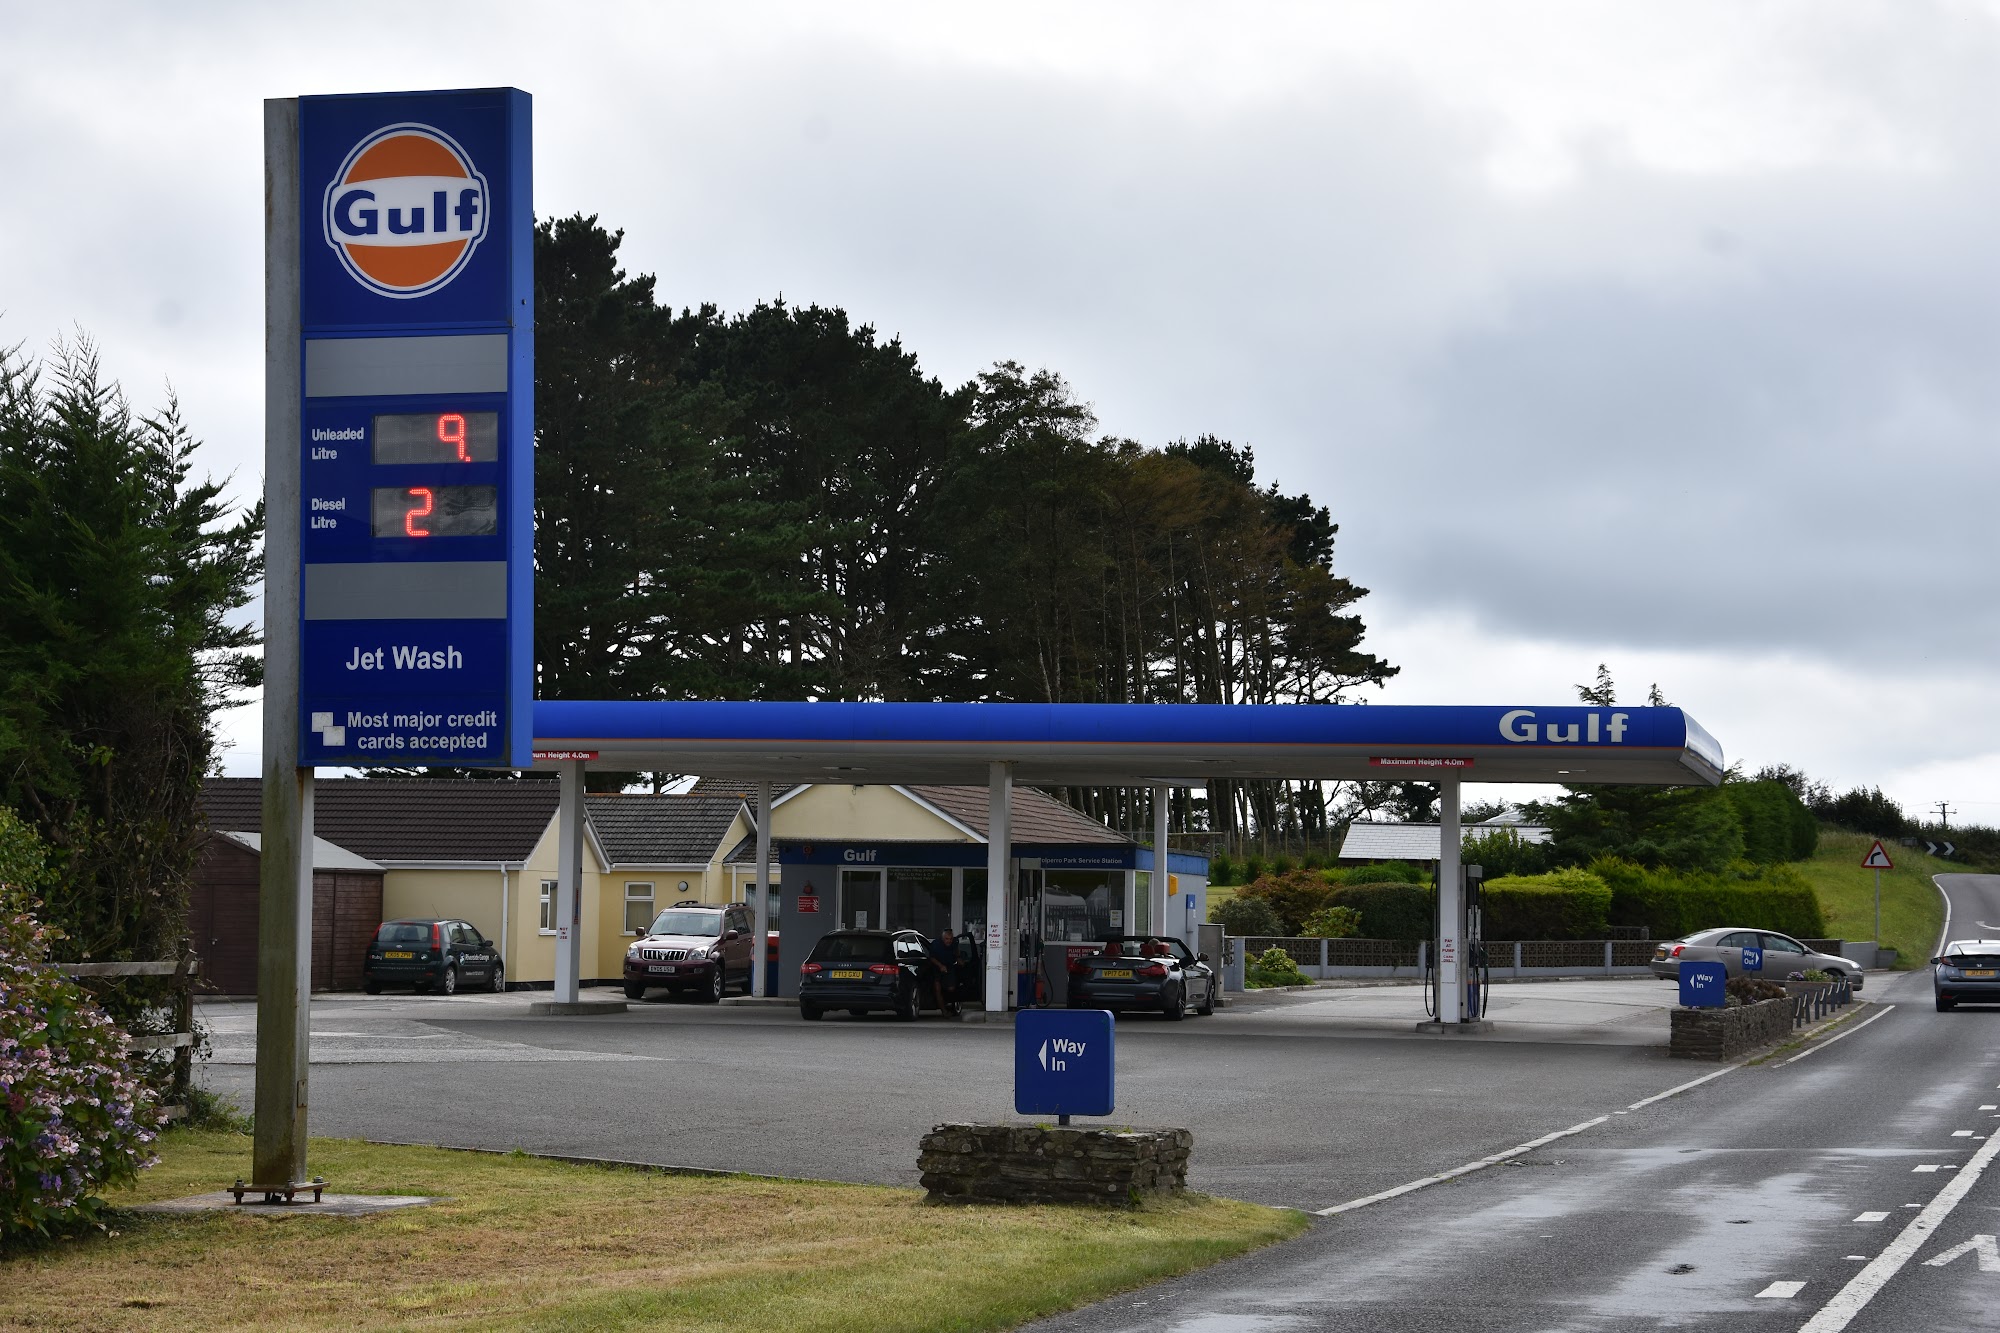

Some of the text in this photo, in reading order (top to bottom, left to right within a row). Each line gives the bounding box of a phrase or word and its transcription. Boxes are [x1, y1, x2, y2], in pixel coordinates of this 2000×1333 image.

[333, 188, 479, 236] Gulf
[311, 427, 364, 441] Unleaded
[311, 448, 338, 460] Litre
[311, 498, 346, 511] Diesel
[405, 487, 432, 537] 2
[311, 517, 337, 529] Litre
[345, 645, 463, 671] Jet Wash
[347, 710, 497, 731] Most major credit
[1498, 709, 1629, 742] Gulf
[357, 732, 488, 752] cards accepted
[547, 752, 570, 760] Height
[1380, 757, 1465, 767] Maximum Height 4.0m
[843, 848, 877, 862] Gulf
[1743, 949, 1755, 958] Way
[1696, 973, 1713, 983] Way
[1052, 1038, 1086, 1057] Way
[1051, 1056, 1066, 1072] In
